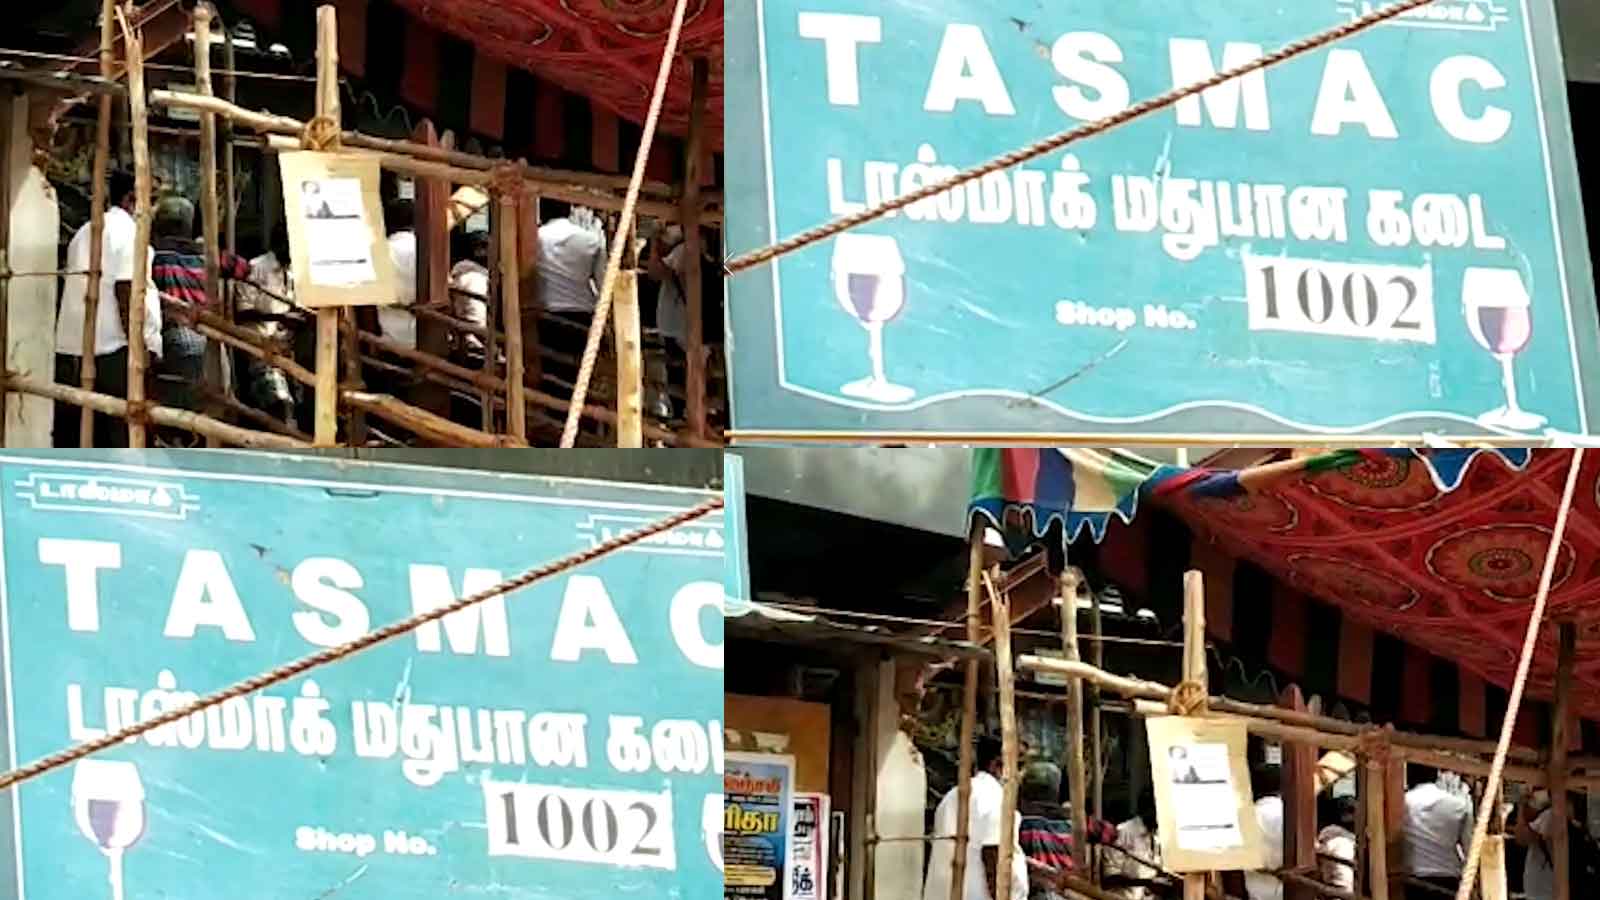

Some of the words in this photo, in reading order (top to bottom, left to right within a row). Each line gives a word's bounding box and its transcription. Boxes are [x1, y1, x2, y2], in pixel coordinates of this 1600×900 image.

[798, 12, 1513, 144] TASMAC
[826, 142, 1097, 229] டாஸ்மாக்
[1111, 174, 1348, 261] மதுபான
[1366, 189, 1506, 250] கடை
[1055, 299, 1136, 332] Shop
[1143, 304, 1197, 330] No.
[1260, 265, 1422, 331] 1002
[37, 537, 724, 669] TASMAC
[66, 668, 338, 756] டாஸ்மாக்
[352, 700, 588, 787] மதுபான
[295, 825, 376, 857] Shop
[383, 829, 437, 856] No.
[500, 791, 662, 856] 1002
